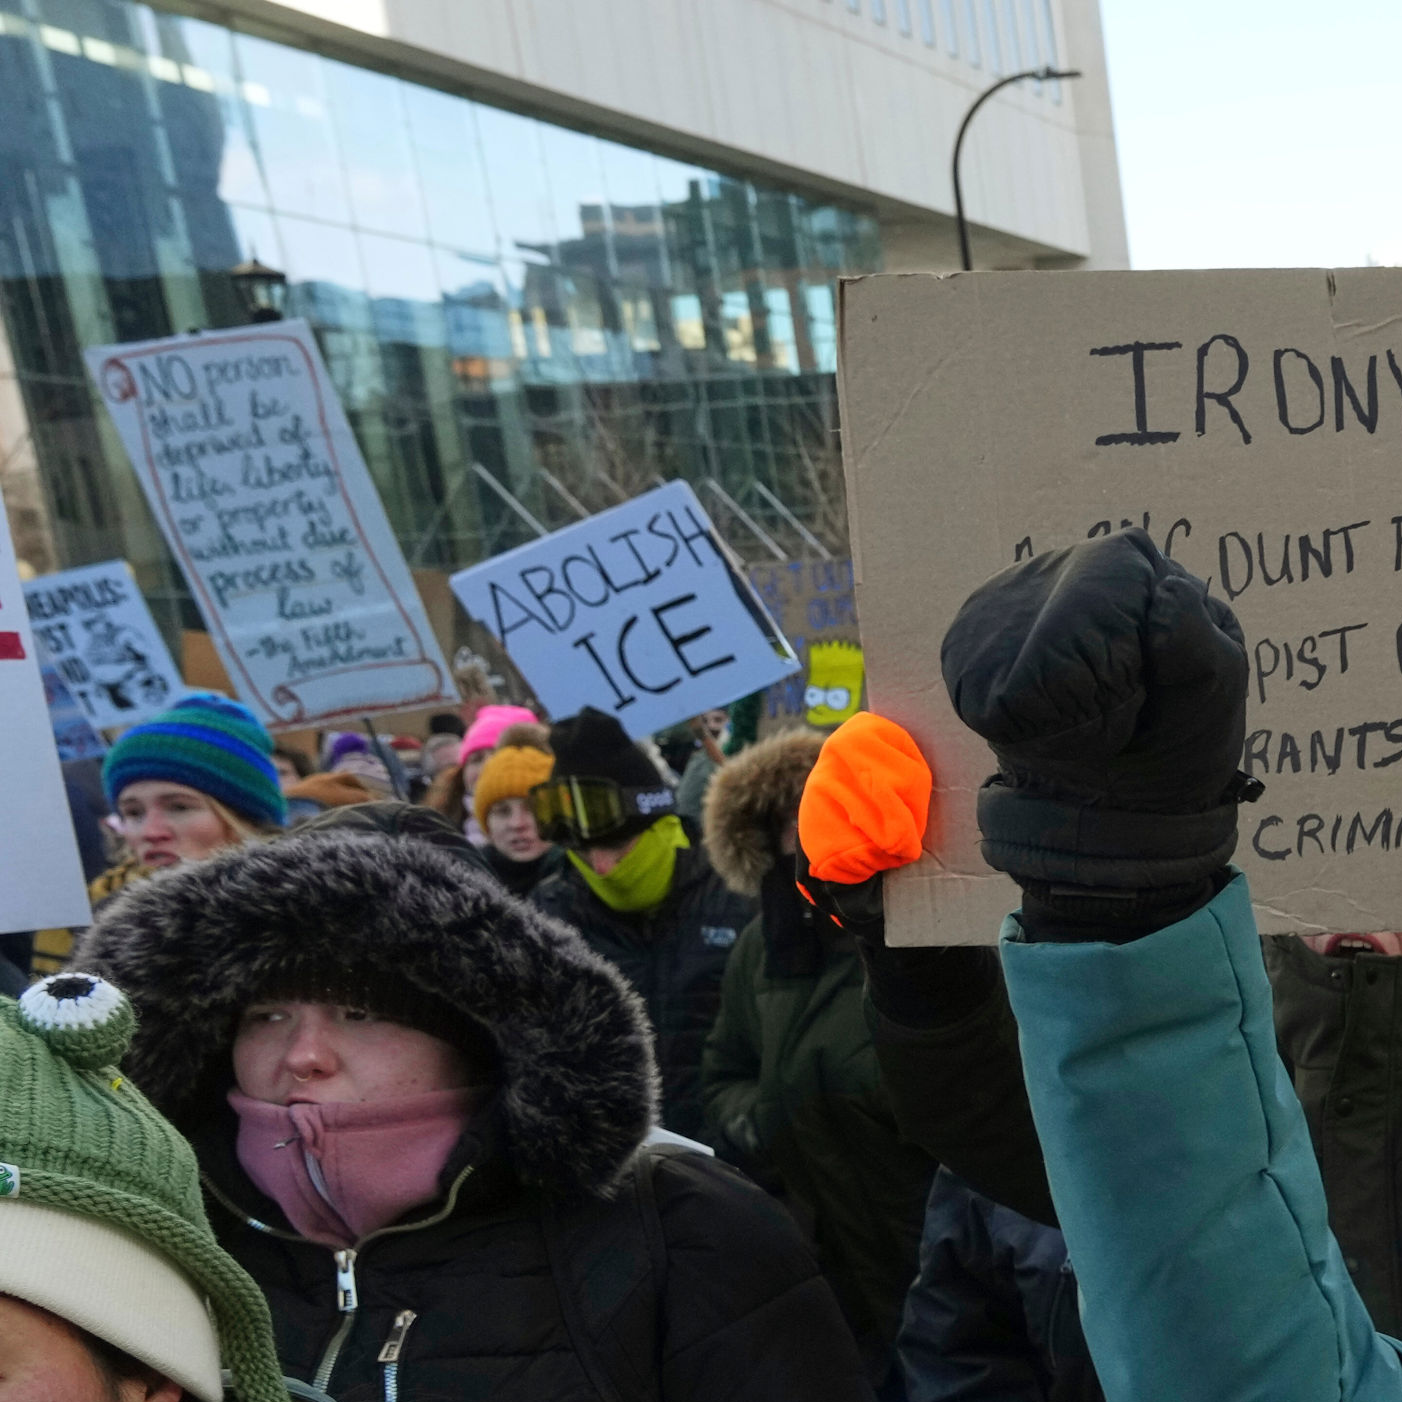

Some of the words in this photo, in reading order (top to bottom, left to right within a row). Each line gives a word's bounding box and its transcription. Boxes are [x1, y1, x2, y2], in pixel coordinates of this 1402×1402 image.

[139, 354, 196, 408] NO
[205, 354, 299, 396] person
[149, 401, 234, 439] shall
[250, 391, 289, 420] be
[158, 424, 265, 468] deprived
[278, 415, 312, 454] of
[188, 526, 293, 562] without
[303, 520, 357, 550] due
[216, 491, 333, 538] property
[211, 557, 316, 609] process
[331, 550, 365, 594] of
[489, 505, 710, 648] ABOLISH
[277, 586, 334, 622] law
[573, 594, 737, 711] ICE
[1254, 622, 1368, 703] PIST
